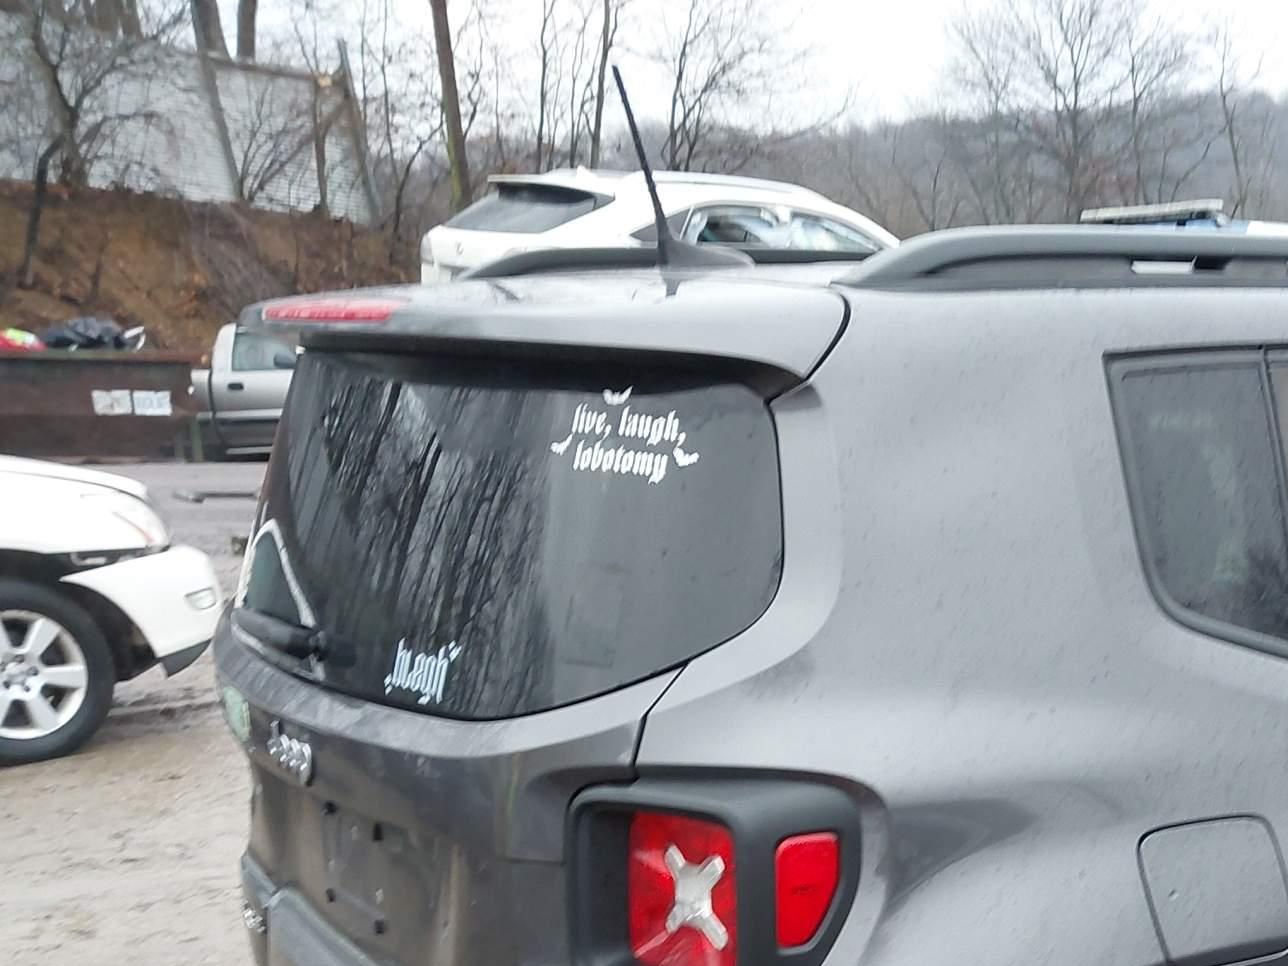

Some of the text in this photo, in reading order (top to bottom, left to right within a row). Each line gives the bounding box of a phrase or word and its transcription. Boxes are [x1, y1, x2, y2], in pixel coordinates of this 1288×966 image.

[572, 402, 687, 448] live, laugh,
[573, 439, 668, 484] lobotomy
